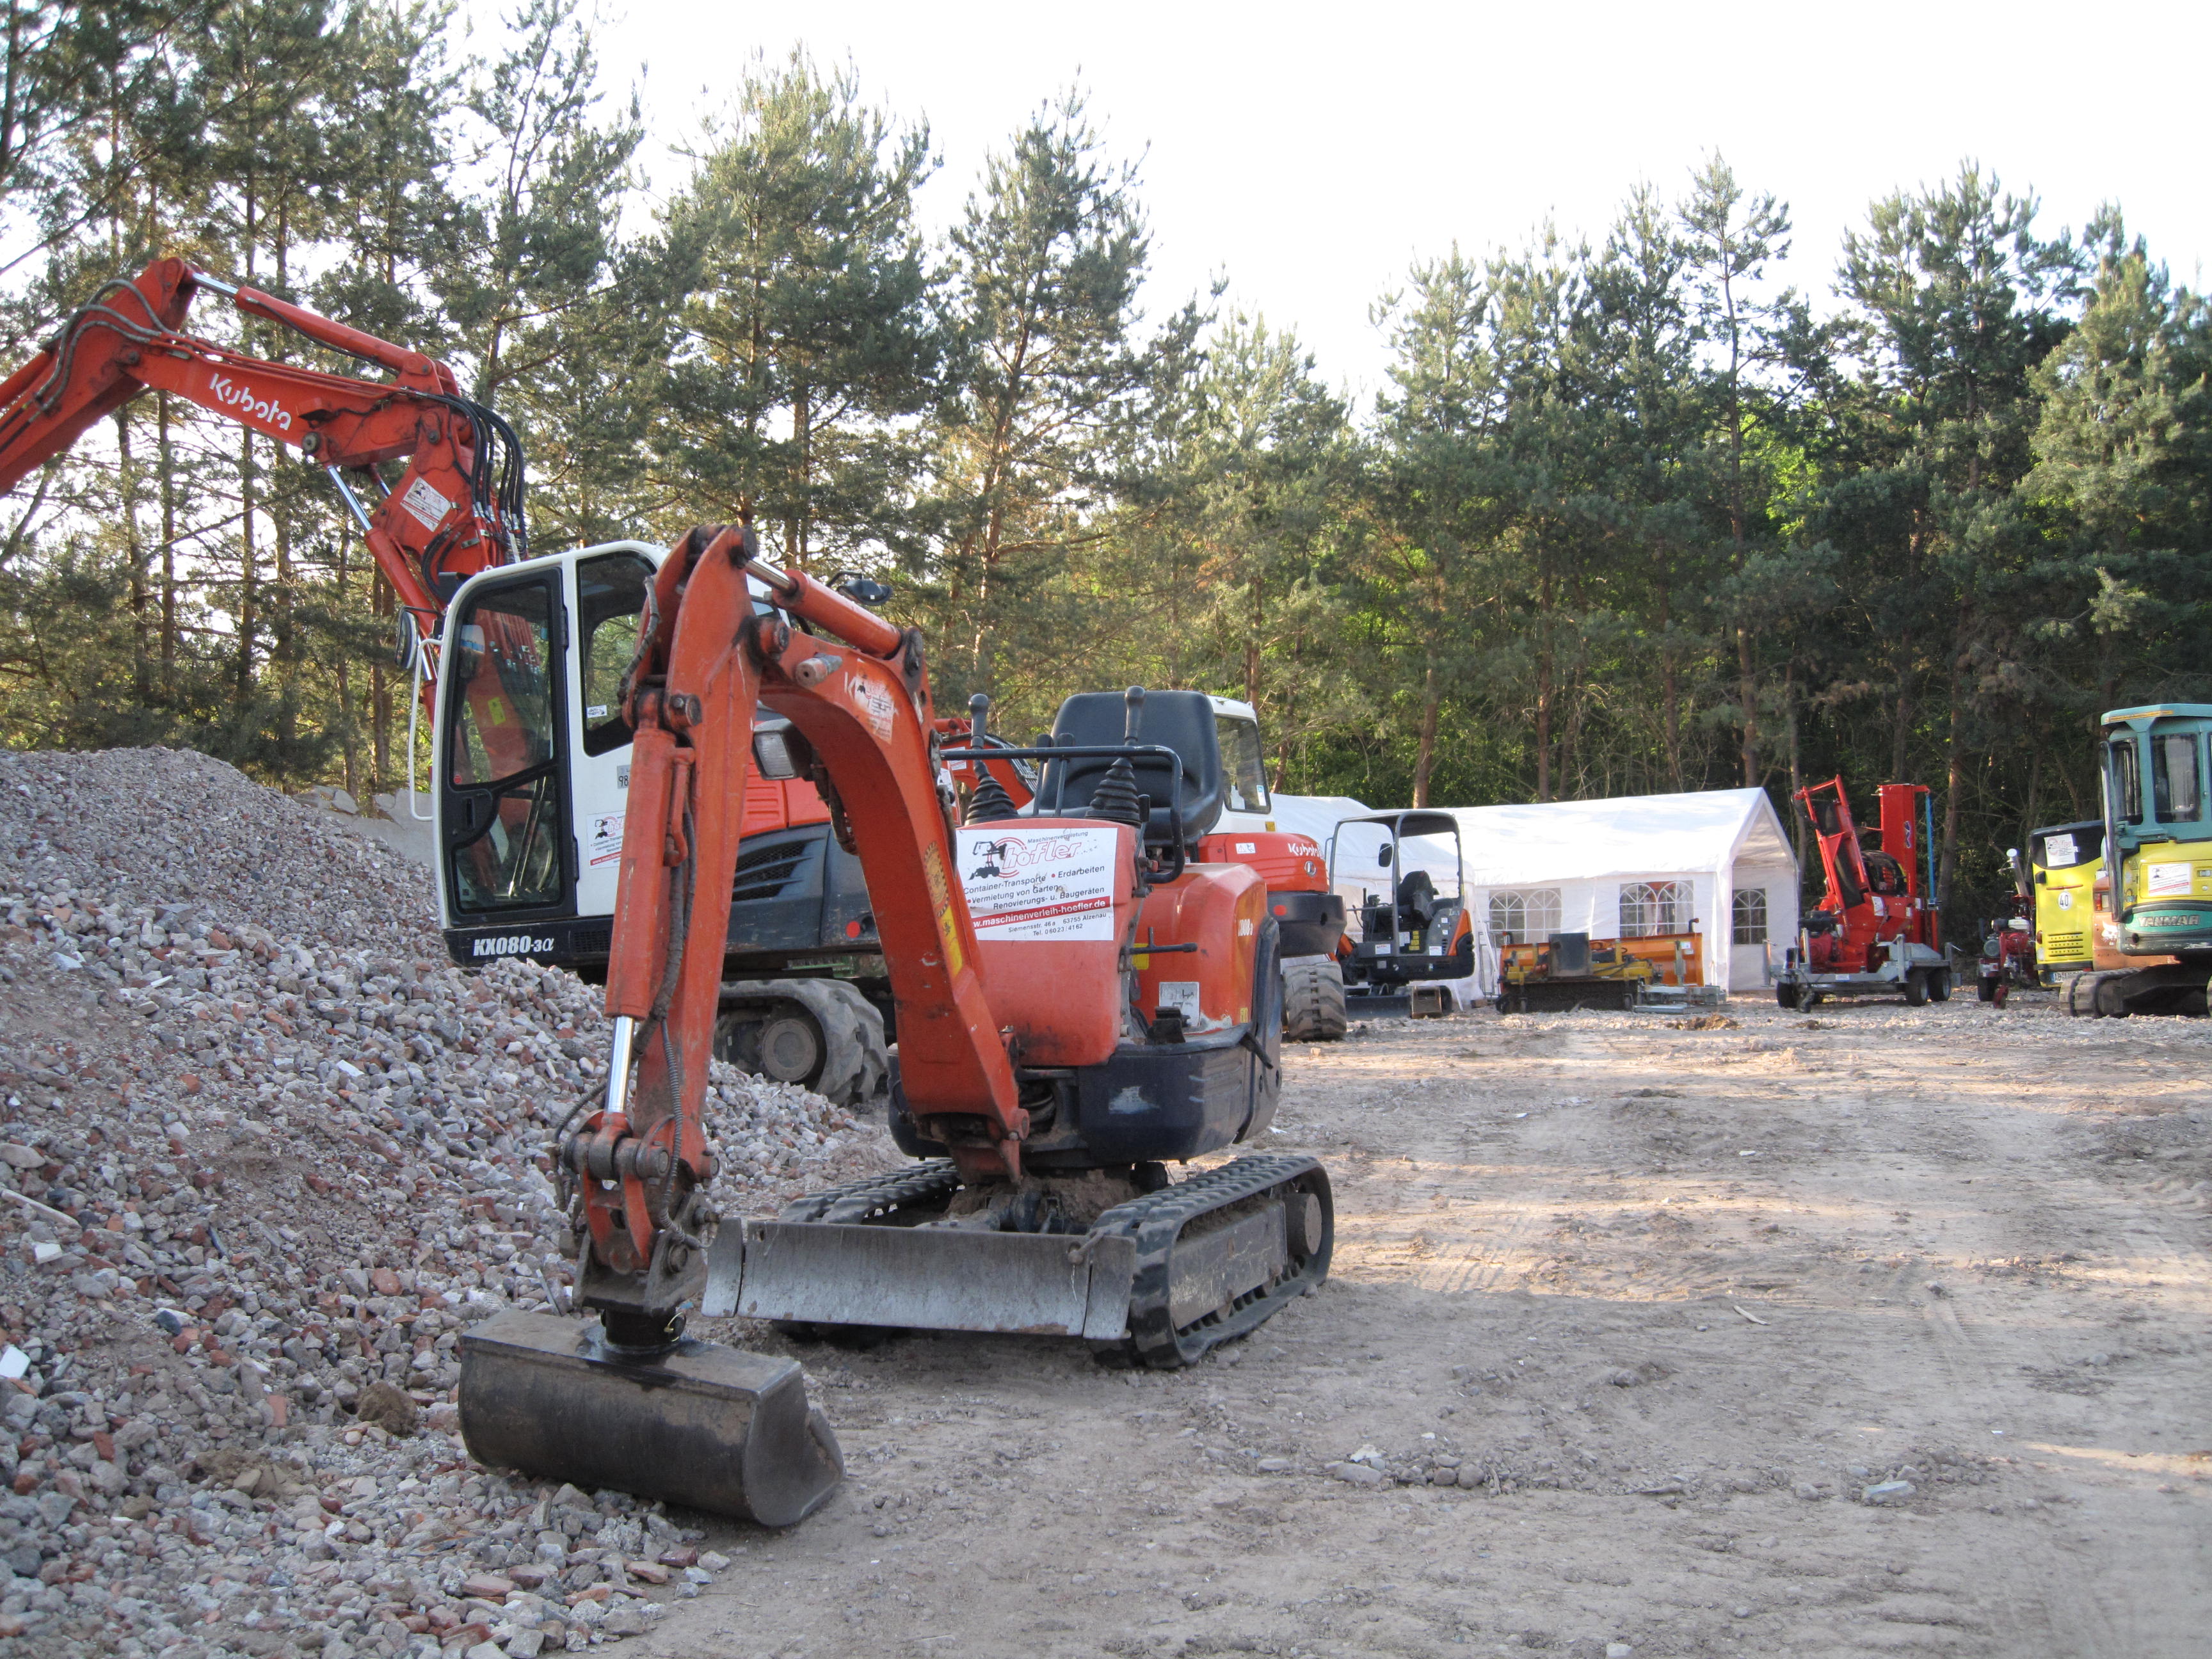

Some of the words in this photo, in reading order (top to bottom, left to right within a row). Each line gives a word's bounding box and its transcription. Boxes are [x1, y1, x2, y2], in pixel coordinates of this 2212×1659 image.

[209, 373, 292, 430] Kubota
[964, 875, 1046, 894] Container-Transporte
[1058, 865, 1105, 878] Erdarbeiten
[972, 892, 1014, 903] Vermietung
[993, 896, 1048, 910] Renovierungs-
[1060, 887, 1105, 899] Baugeräten
[2060, 895, 2069, 907] 40
[973, 900, 1106, 927] w.maschinenverleih-hoefler.de
[1008, 923, 1042, 933] Siemensstr.
[1083, 913, 1107, 921] Alzenau
[2138, 914, 2200, 927] YANMAR
